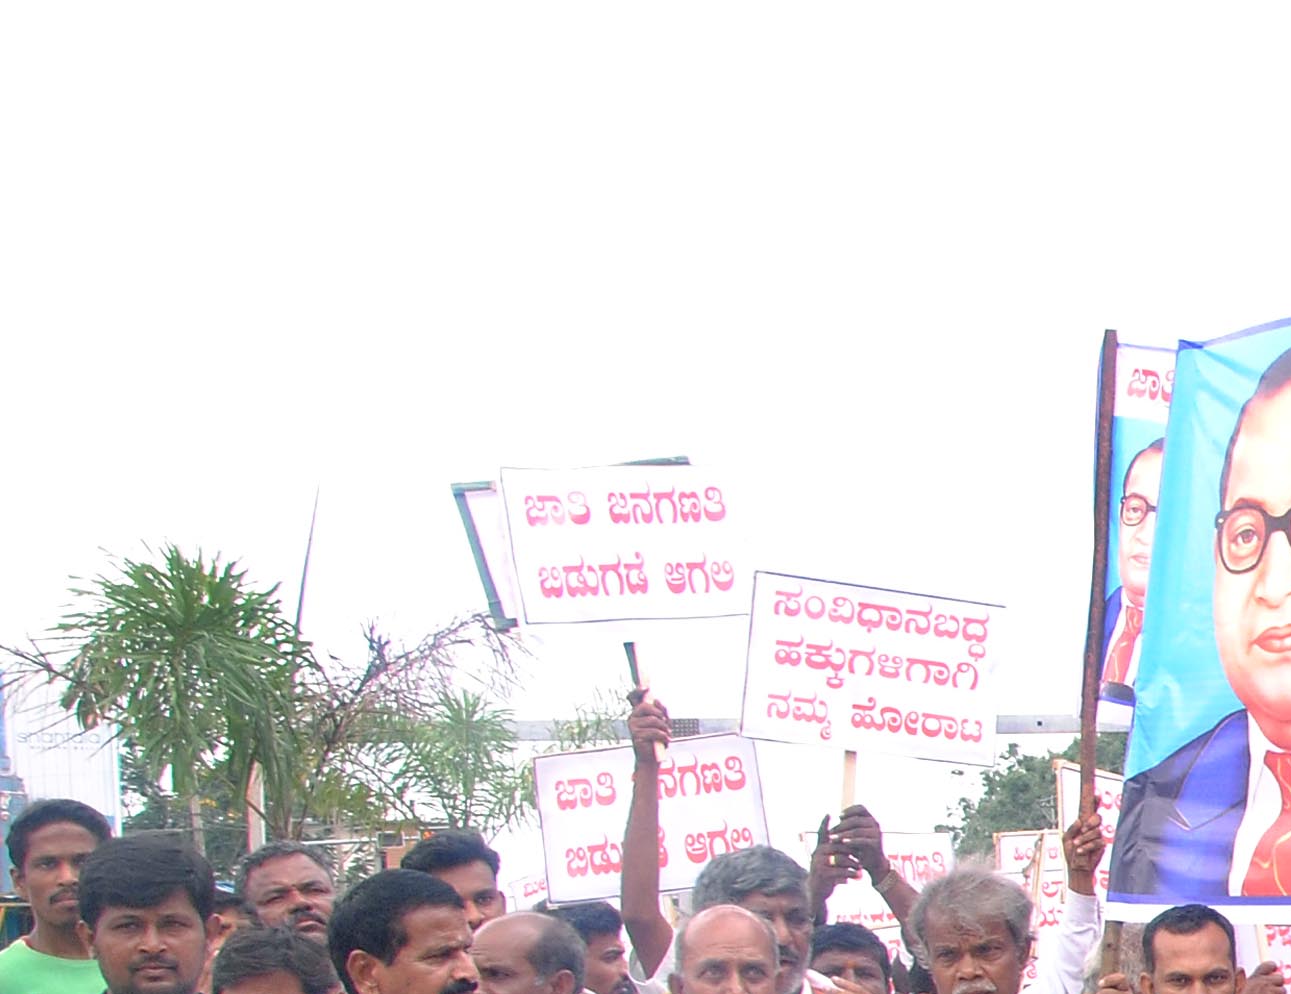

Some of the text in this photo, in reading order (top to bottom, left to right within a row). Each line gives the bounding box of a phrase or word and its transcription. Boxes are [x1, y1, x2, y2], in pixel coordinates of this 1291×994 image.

[524, 485, 727, 527] ಜಾತಿ ಜನಗಣತಿ
[538, 552, 735, 599] ಬಿಡುಗಡೆ ಆಗಲಿ
[774, 590, 989, 662] ಸಂವಿಧಾನಬದ್ಧ
[774, 636, 980, 690] ಹಕ್ಕುಗಳಿಗಾಗಿ
[767, 692, 982, 743] ನಮ್ಮ ಹೋರಾಟ
[555, 755, 747, 811] ಜಾತಿ ನಗಣತಿ
